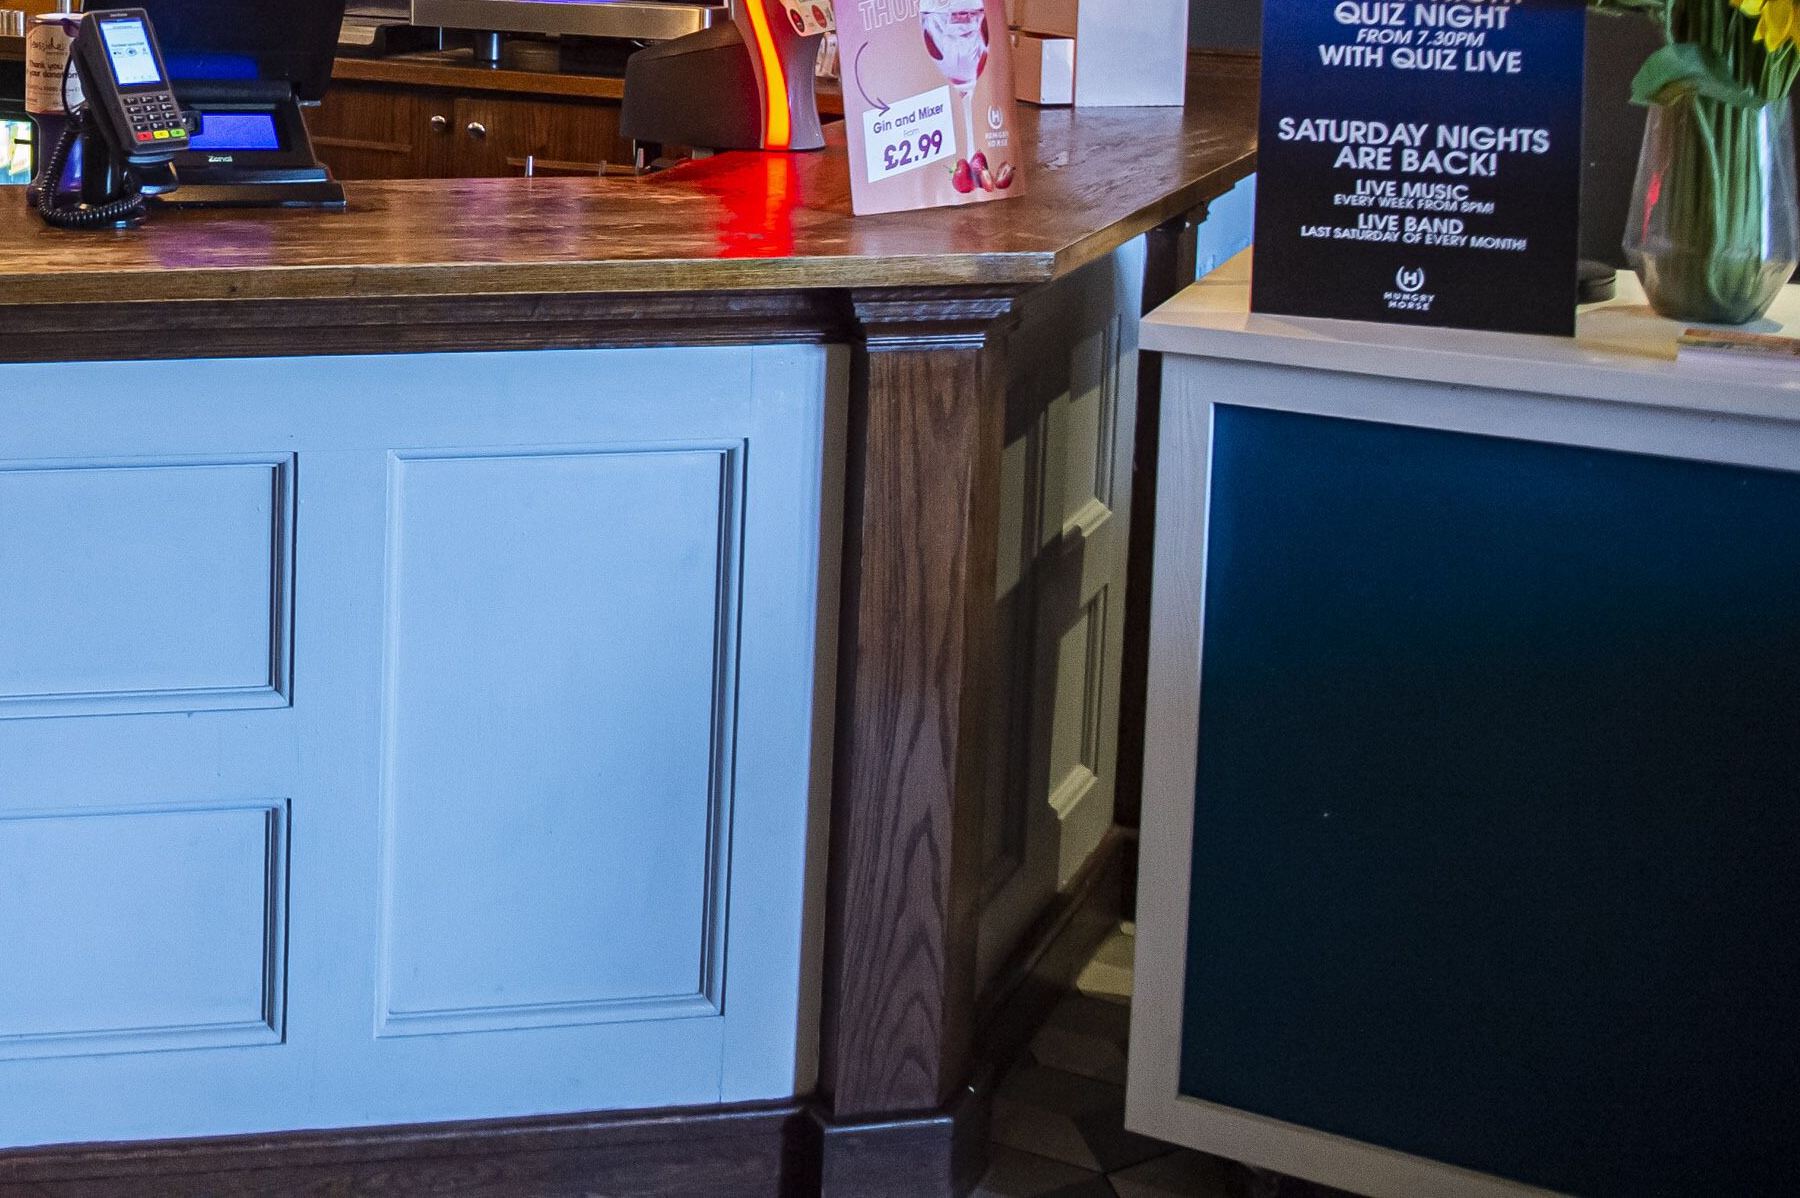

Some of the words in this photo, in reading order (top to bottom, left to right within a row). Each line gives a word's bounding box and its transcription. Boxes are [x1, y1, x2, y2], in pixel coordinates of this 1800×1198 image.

[1333, 1, 1405, 26] QUIZ
[1414, 3, 1510, 29] NIGHT
[1356, 28, 1412, 44] FROM
[1417, 30, 1486, 48] 7.30PM
[1318, 44, 1384, 67] WITH
[1390, 47, 1457, 71] QUIZ
[1464, 49, 1522, 74] LIVE
[873, 120, 892, 134] Gin
[895, 112, 916, 128] and
[918, 103, 944, 120] Mixer
[1278, 117, 1429, 147] SATURDAY
[1436, 124, 1550, 154] NIGHTS
[883, 129, 943, 171] £2.99
[1333, 146, 1392, 171] ARE
[1401, 148, 1498, 178] BACK!
[1355, 178, 1397, 197] LIVE
[1402, 181, 1470, 201] MUSIC
[1333, 194, 1376, 206] EVERY
[1378, 196, 1415, 209] WEEK
[1416, 198, 1458, 212] FROM
[1357, 213, 1399, 232] LIVE
[1404, 216, 1464, 235] BAND
[1300, 225, 1332, 238] LAST
[1333, 226, 1399, 243] SATURDAY
[1402, 232, 1424, 244] OF
[1424, 233, 1468, 248] EVERY
[1383, 292, 1436, 303] HUNGRY
[1387, 301, 1430, 311] HORSE
